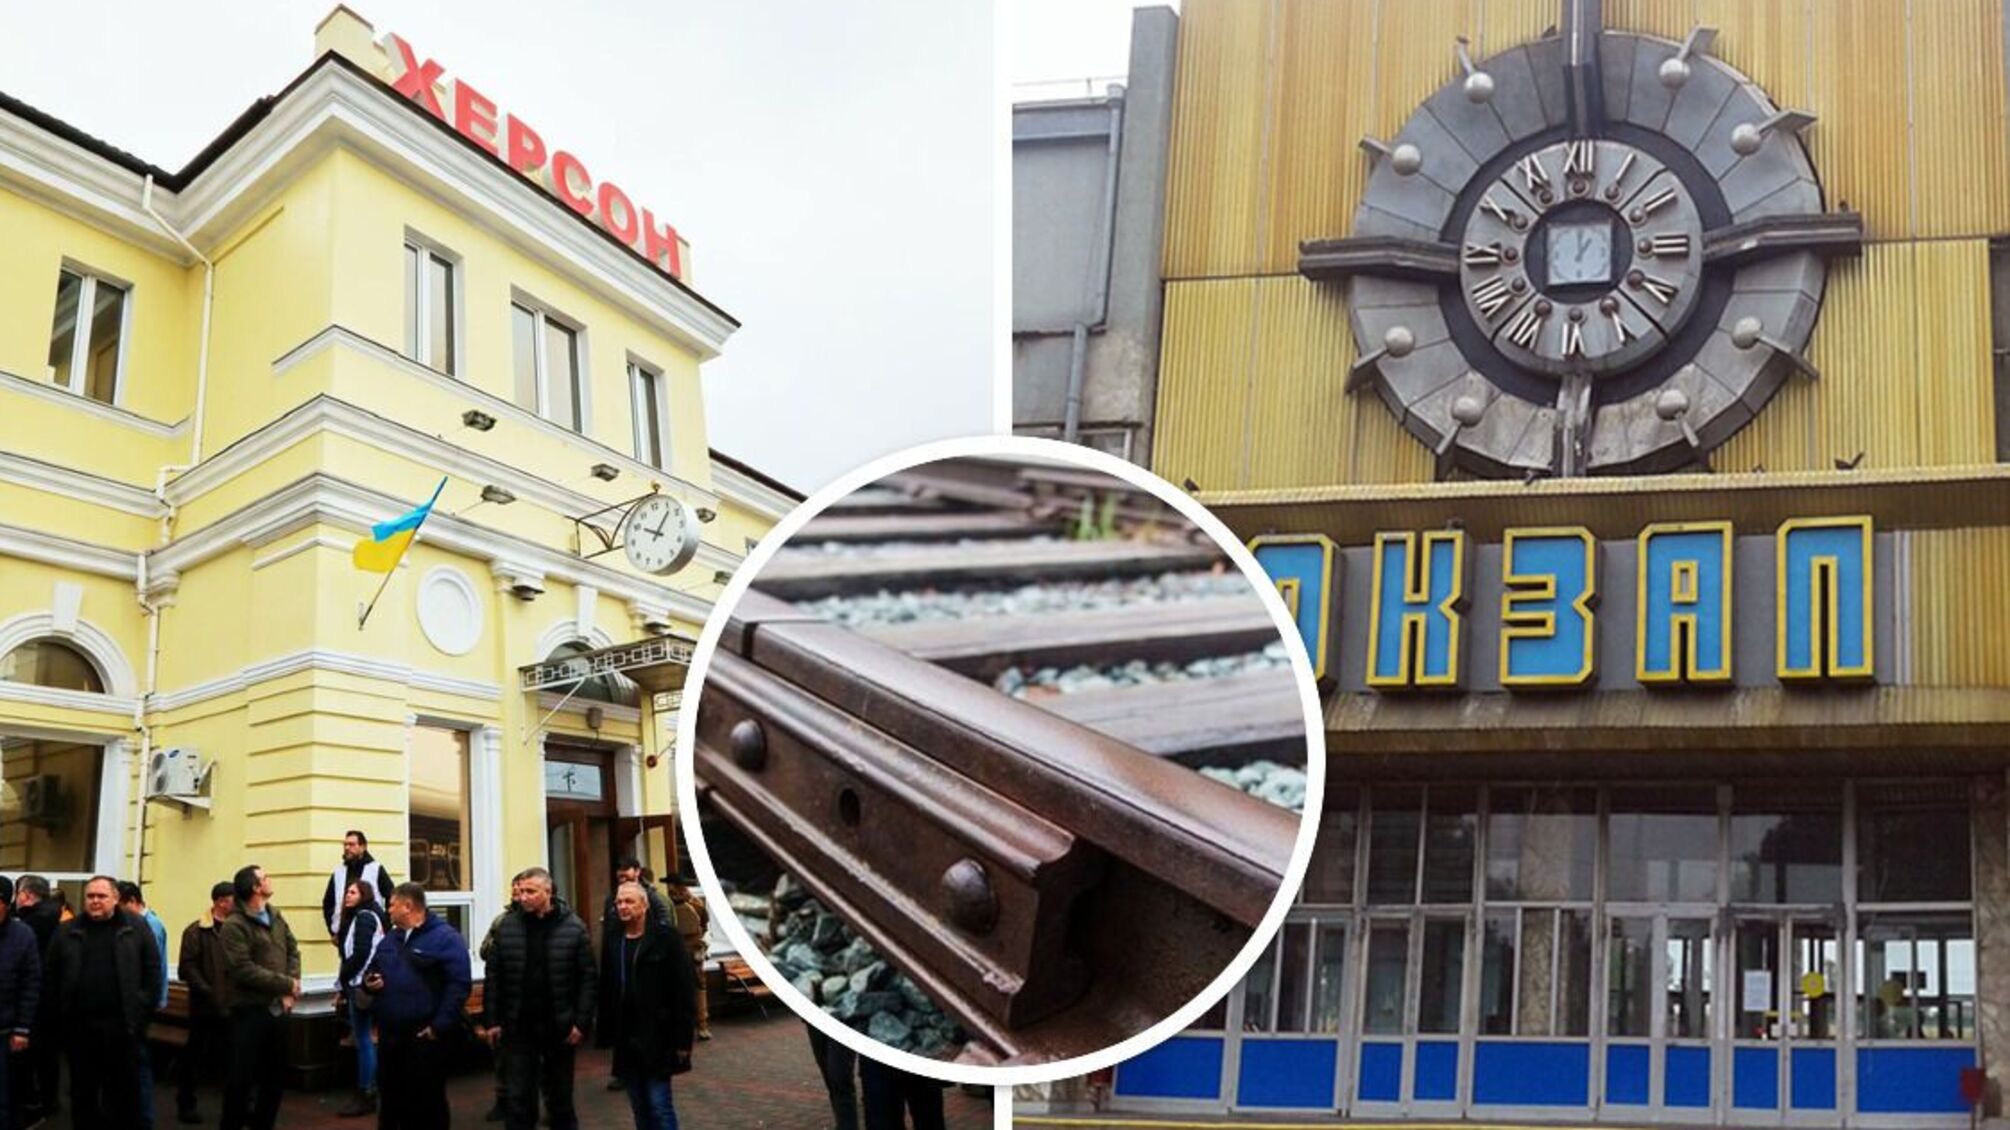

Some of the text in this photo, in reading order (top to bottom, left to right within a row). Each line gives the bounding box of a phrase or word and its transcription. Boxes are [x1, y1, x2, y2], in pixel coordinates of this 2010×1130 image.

[391, 31, 681, 281] ХЕРСОН
[1516, 152, 1548, 189] XI
[1563, 140, 1593, 173] XII
